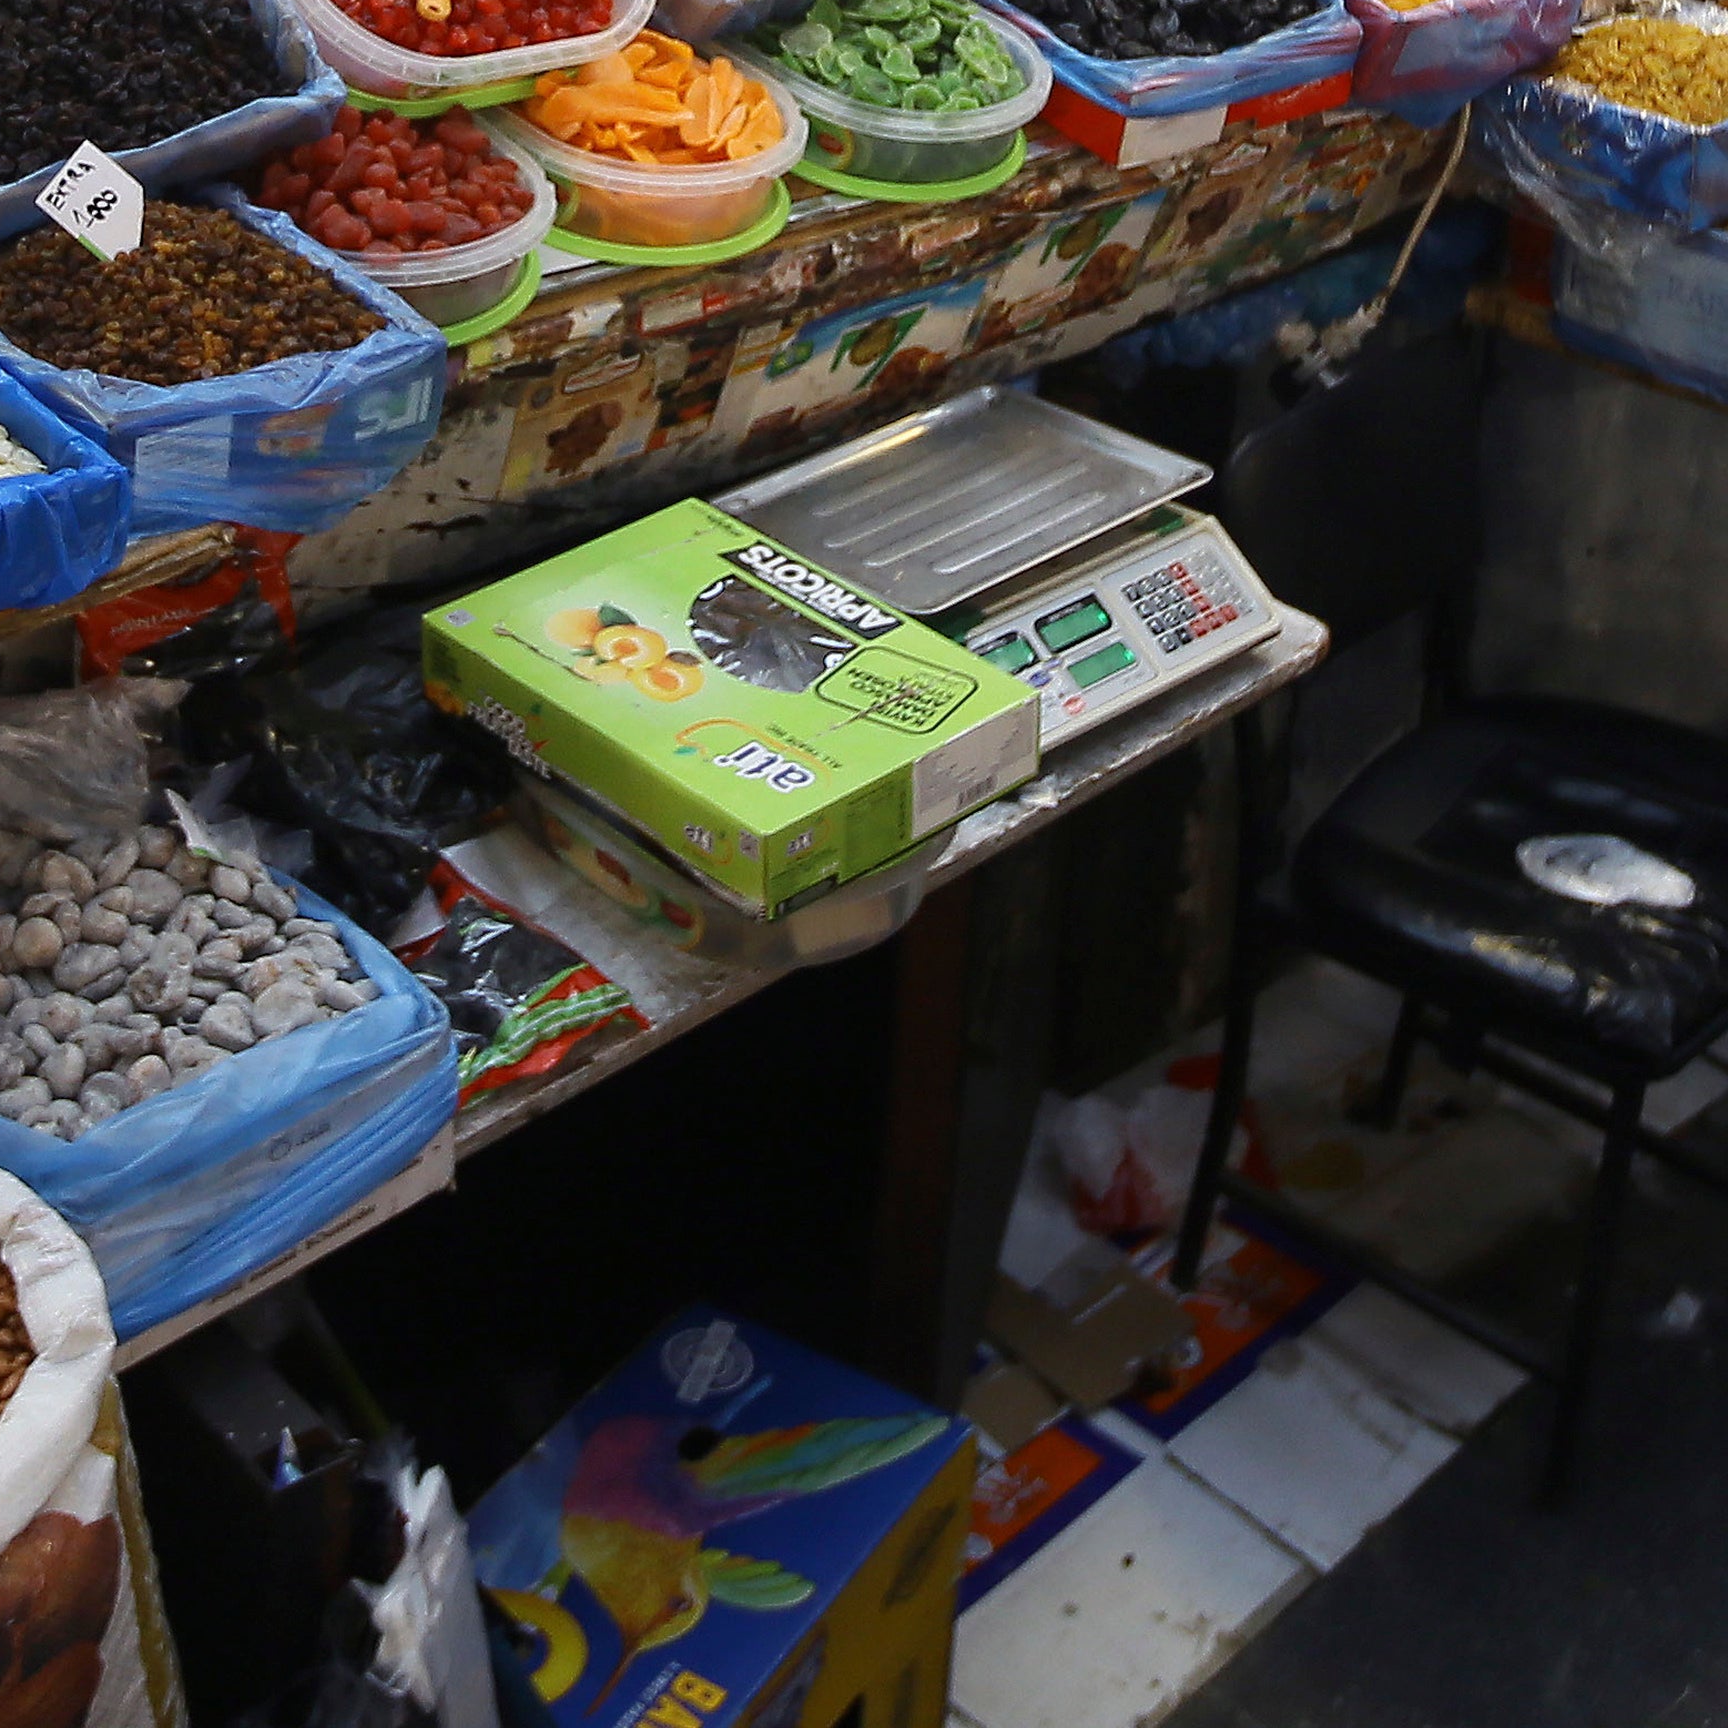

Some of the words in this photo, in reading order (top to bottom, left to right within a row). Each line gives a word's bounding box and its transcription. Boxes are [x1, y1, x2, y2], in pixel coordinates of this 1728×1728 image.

[45, 162, 97, 212] EXTRA
[737, 543, 898, 632] APRICOTS
[713, 740, 816, 793] ati
